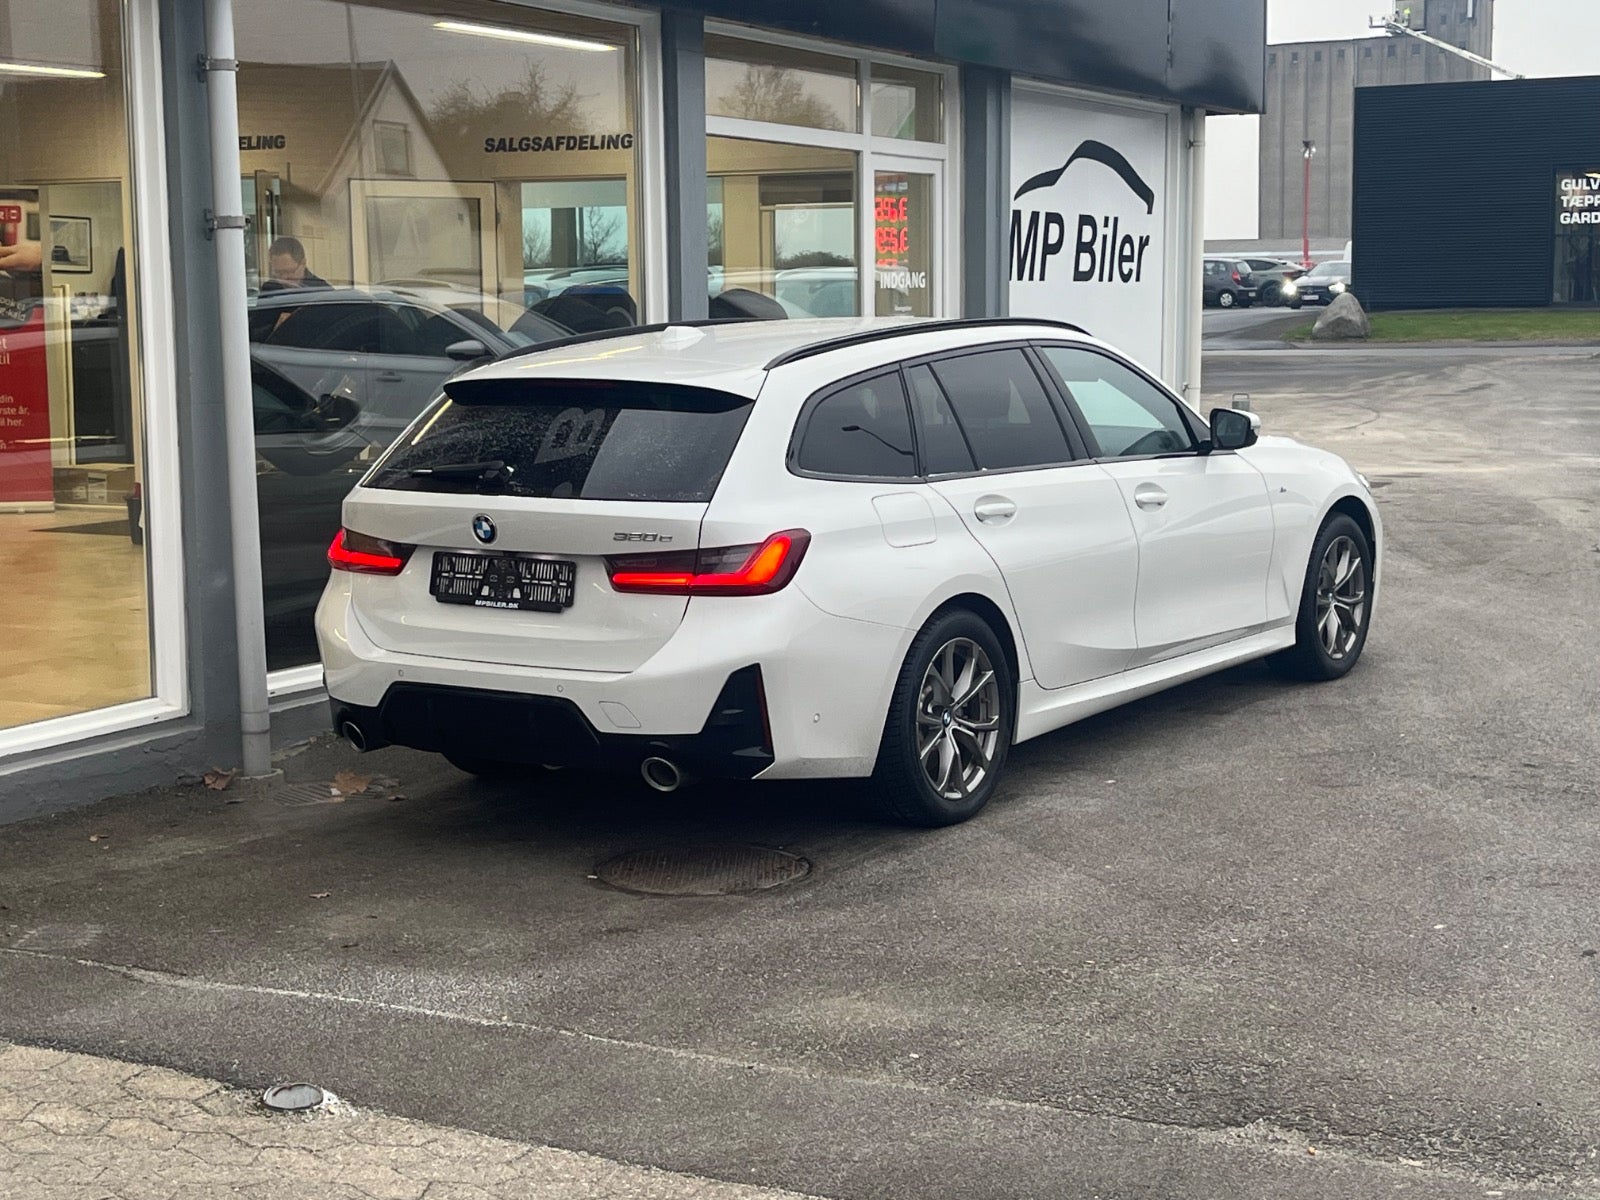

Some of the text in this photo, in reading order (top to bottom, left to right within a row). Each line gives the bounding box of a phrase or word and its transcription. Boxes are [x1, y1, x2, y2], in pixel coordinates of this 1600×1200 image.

[484, 134, 633, 153] SALGSAFDELING
[1561, 178, 1600, 190] GULV
[1560, 211, 1600, 224] GARD
[1009, 209, 1150, 283] MP Biler
[880, 271, 925, 288] INDGANG
